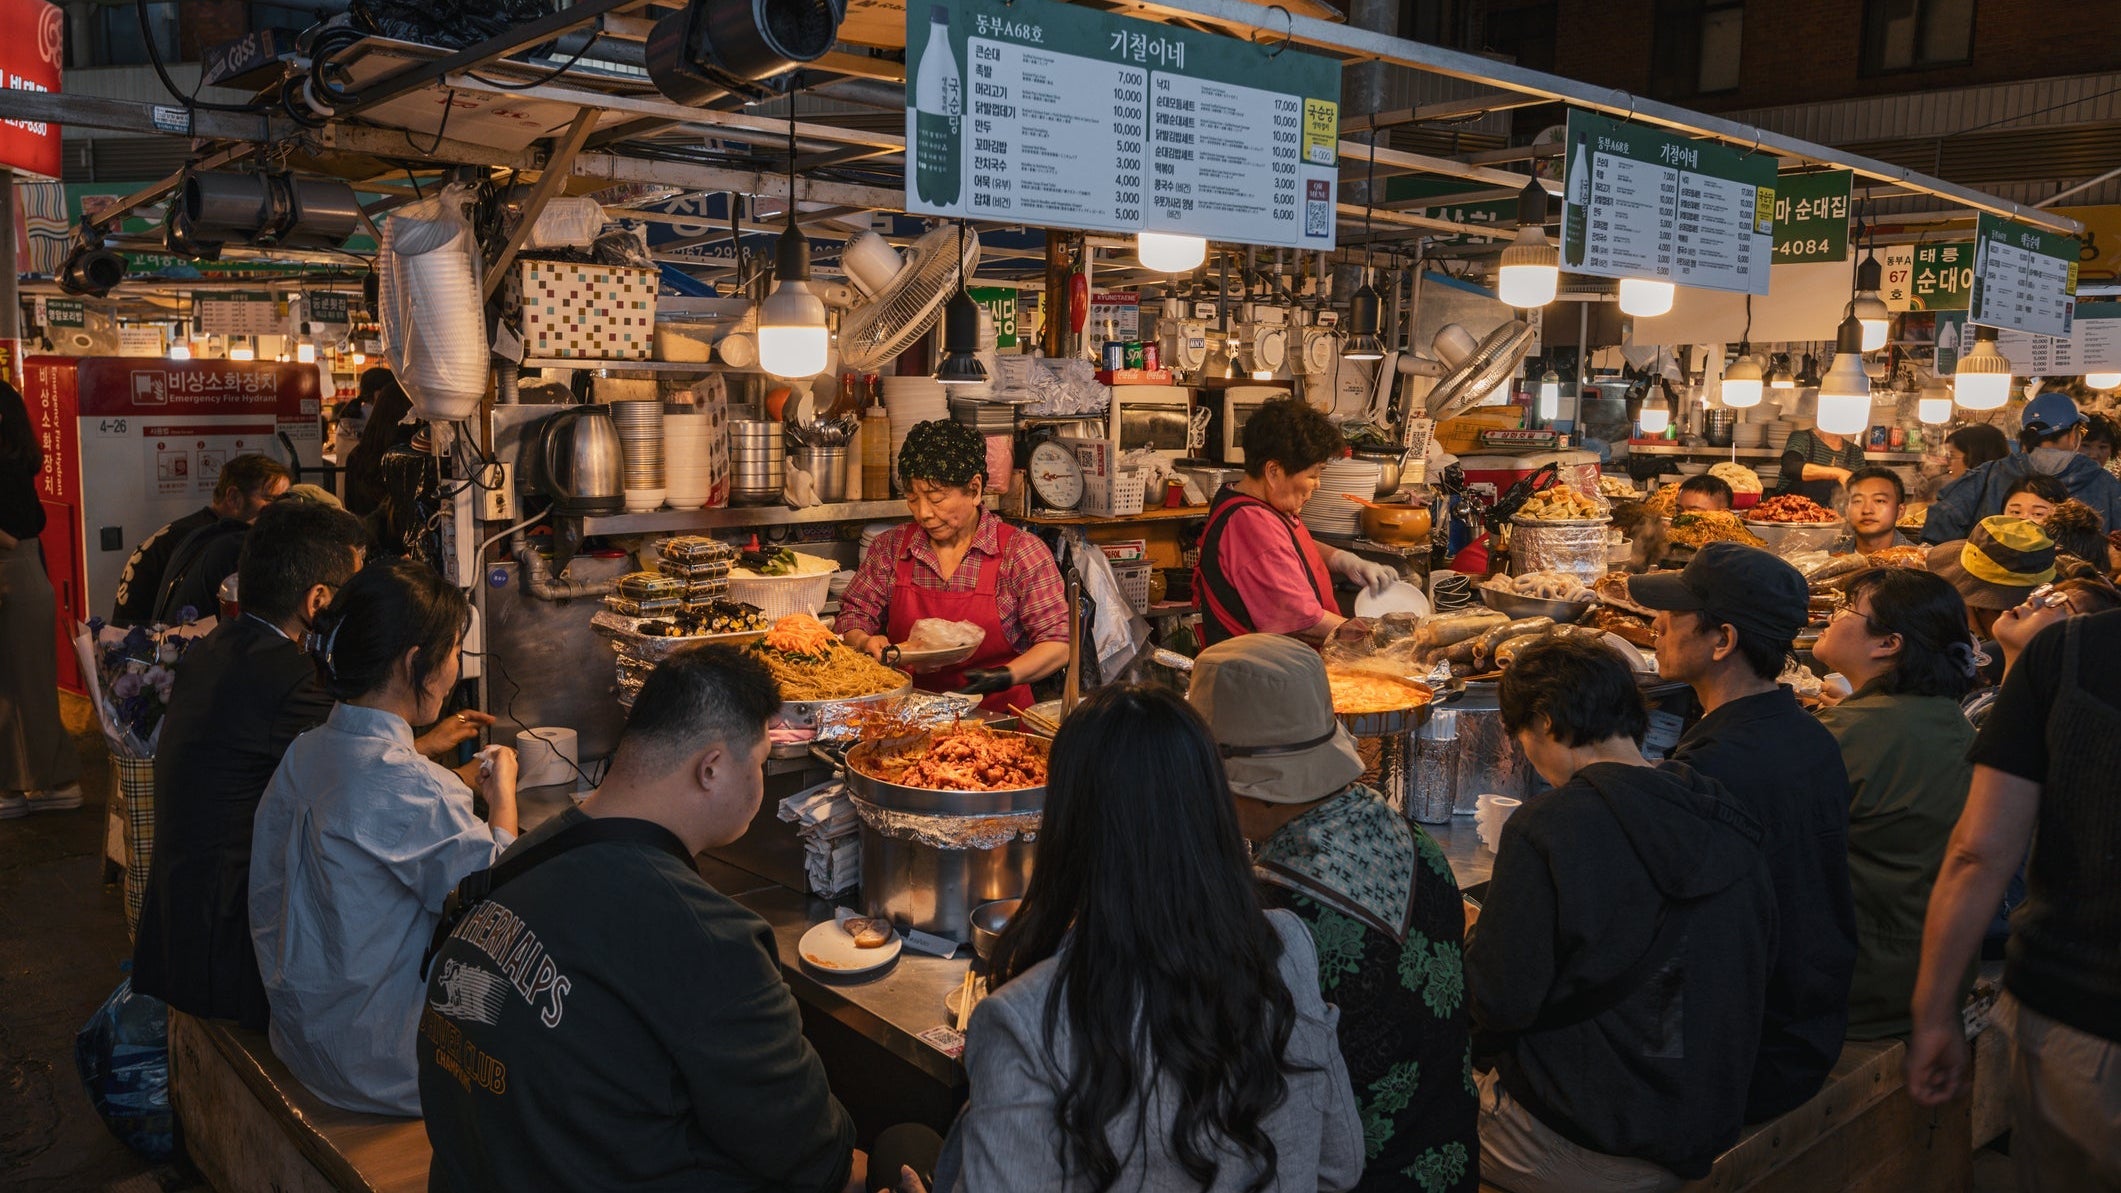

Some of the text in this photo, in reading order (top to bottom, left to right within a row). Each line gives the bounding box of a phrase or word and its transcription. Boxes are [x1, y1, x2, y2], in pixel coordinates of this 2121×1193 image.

[976, 13, 1044, 43] 동부A68호
[976, 45, 1001, 61] 큰순대
[1110, 30, 1185, 69] 기철이네
[976, 63, 992, 79] 족발
[1118, 71, 1142, 86] 7,000
[975, 82, 1007, 99] 머리고기
[1156, 78, 1170, 91] 낙지
[1114, 88, 1142, 103] 10,000
[949, 78, 960, 135] 국순당
[975, 101, 1016, 119] 닭발껍데기
[1156, 95, 1195, 112] 순대모듬세트
[1274, 99, 1298, 112] 17,000
[1114, 105, 1142, 120] 10,000
[1155, 112, 1195, 128] 닭발순대세트
[1307, 104, 1334, 123] 국순당
[975, 119, 992, 133] 만두
[1273, 115, 1297, 128] 10,000
[1113, 122, 1141, 137] 10,000
[1155, 128, 1195, 144] 닭발김밥세트
[1273, 130, 1297, 144] 10,000
[975, 138, 1008, 154] 꼬마김밥
[1116, 140, 1141, 153] 5,000
[1155, 145, 1194, 160] 순대김밥세트
[1272, 146, 1296, 159] 10,000
[1597, 136, 1630, 154] 동부A68호
[1116, 157, 1141, 170] 3,000
[1660, 143, 1698, 169] 기철이네
[974, 156, 1007, 172] 잔치국수
[1155, 162, 1175, 175] 떡볶이
[1271, 162, 1295, 174] 10,000
[974, 175, 991, 189] 어묵
[992, 178, 1011, 191] (유부)
[1115, 174, 1140, 187] 4,000
[1154, 179, 1174, 191] 콩국수
[1175, 182, 1191, 194] (비건)
[1274, 178, 1295, 190] 3,000
[1313, 182, 1323, 190] QR
[974, 193, 991, 206] 잡채
[992, 196, 1011, 209] (비건)
[1115, 191, 1140, 204] 3,000
[1273, 193, 1294, 205] 6,000
[1310, 190, 1326, 198] MENU
[1115, 208, 1139, 221] 5,000
[1273, 208, 1294, 220] 6,000
[1795, 195, 1847, 221] 순대집
[1771, 238, 1830, 255] -4084
[1889, 270, 1908, 283] 67
[1889, 288, 1904, 300] 호
[979, 298, 1016, 335] 식당
[168, 371, 277, 392] 비상소화장치
[52, 366, 60, 428] Emergency
[170, 395, 220, 404] Emergency
[242, 394, 277, 404] Hydrant
[40, 366, 53, 495] 비상소화장치
[100, 419, 127, 433] 4-26
[501, 929, 572, 1028] ALPS
[463, 1039, 507, 1095] CLUB
